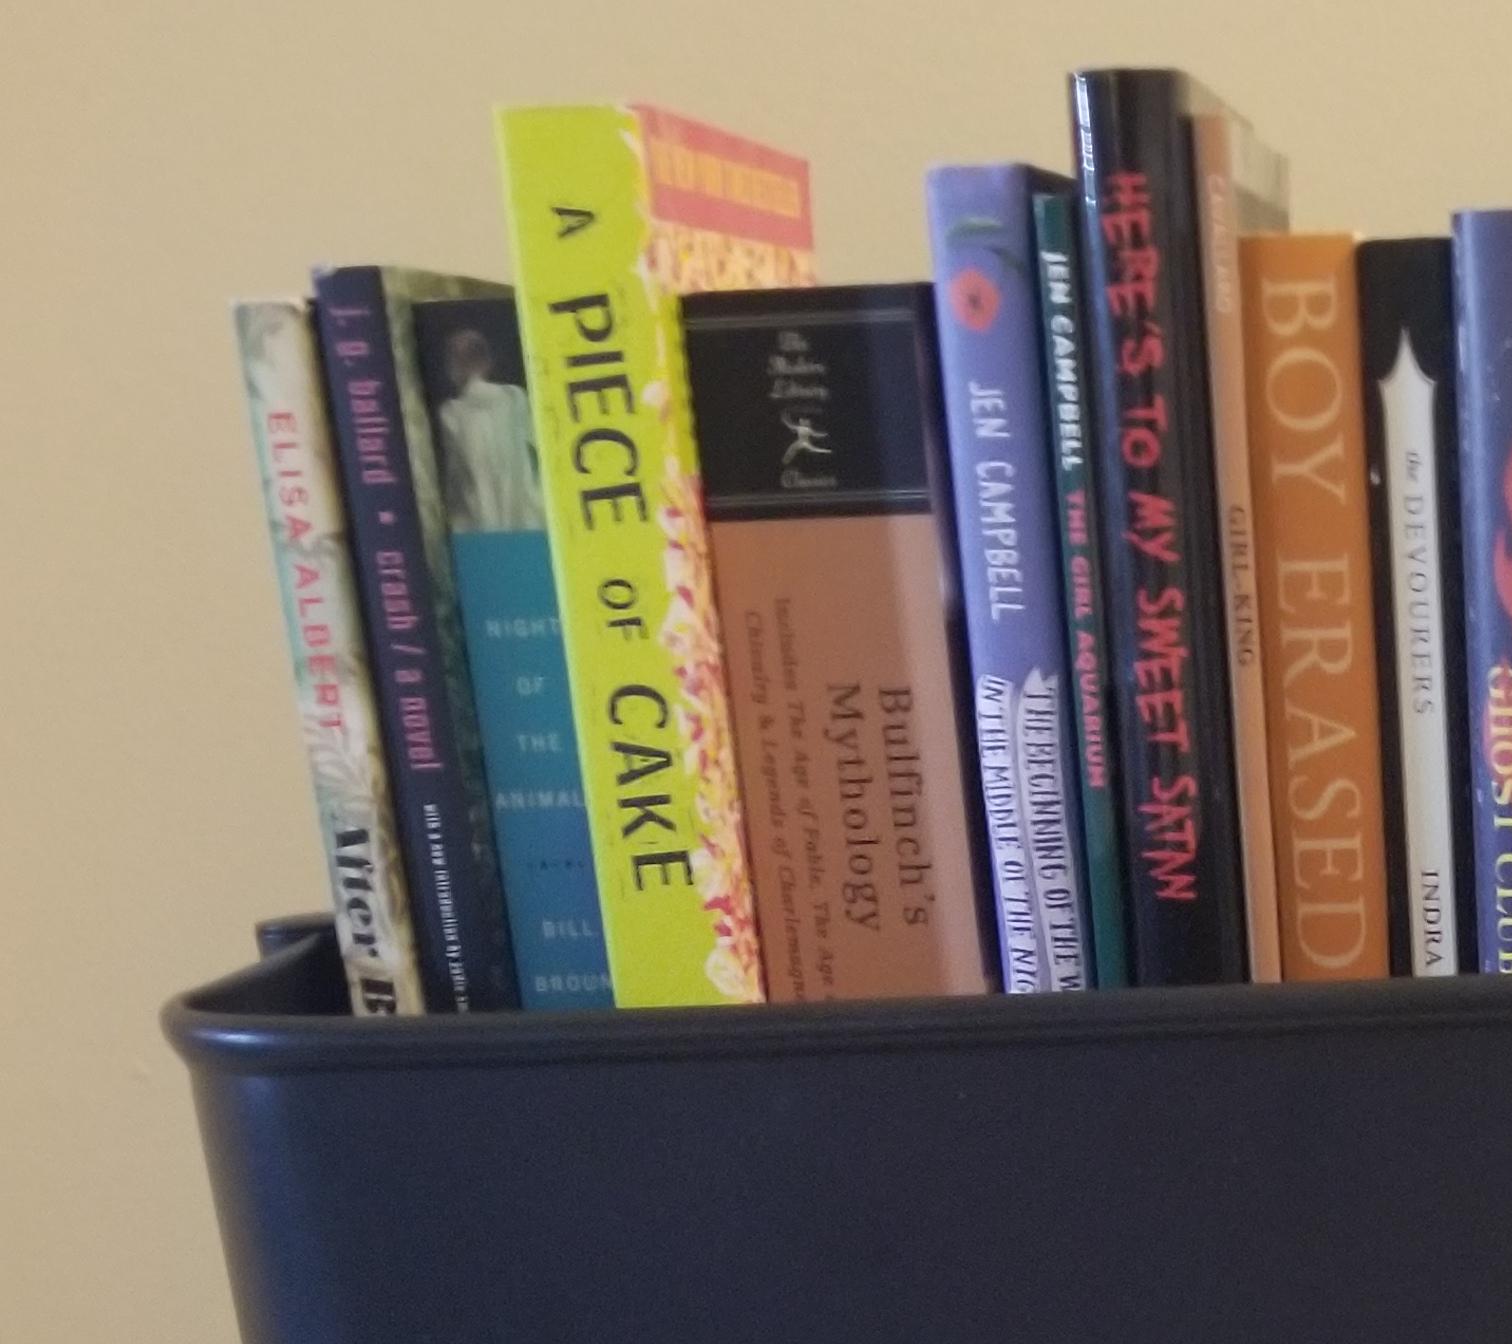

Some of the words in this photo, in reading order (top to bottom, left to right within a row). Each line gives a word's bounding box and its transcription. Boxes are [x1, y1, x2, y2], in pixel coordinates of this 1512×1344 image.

[550, 204, 598, 240] A
[1040, 251, 1072, 305] JEN
[1099, 171, 1167, 376] HERE'S
[547, 293, 649, 532] PIECE
[969, 380, 1012, 440] JEN
[1048, 313, 1085, 471] CAMPBELL
[1120, 395, 1168, 469] TO
[1260, 277, 1348, 506] BOY
[266, 411, 314, 542] ELISA
[293, 562, 346, 733] ALBERT
[347, 380, 397, 484] ballard
[375, 550, 420, 629] crash
[399, 697, 444, 770] novel
[975, 460, 1026, 621] CAMPBELL
[1065, 489, 1089, 547] THE
[1069, 556, 1093, 618] GIRL
[1120, 491, 1183, 564] MY
[597, 577, 650, 643] OF
[1132, 586, 1190, 754] SWEET
[1402, 495, 1437, 716] DEVOURERS
[1073, 630, 1106, 789] AQUARIUM
[1276, 552, 1368, 970] ERASED
[607, 682, 696, 892] CAKE
[825, 682, 883, 933] Mythology
[878, 685, 937, 928] Bulfinch's
[983, 764, 1020, 850] MIDDLE
[1023, 741, 1070, 882] BEGINNING
[1137, 776, 1199, 901] SATAN
[335, 827, 380, 957] After
[543, 920, 595, 939] BILL
[1420, 870, 1444, 967] INDRA
